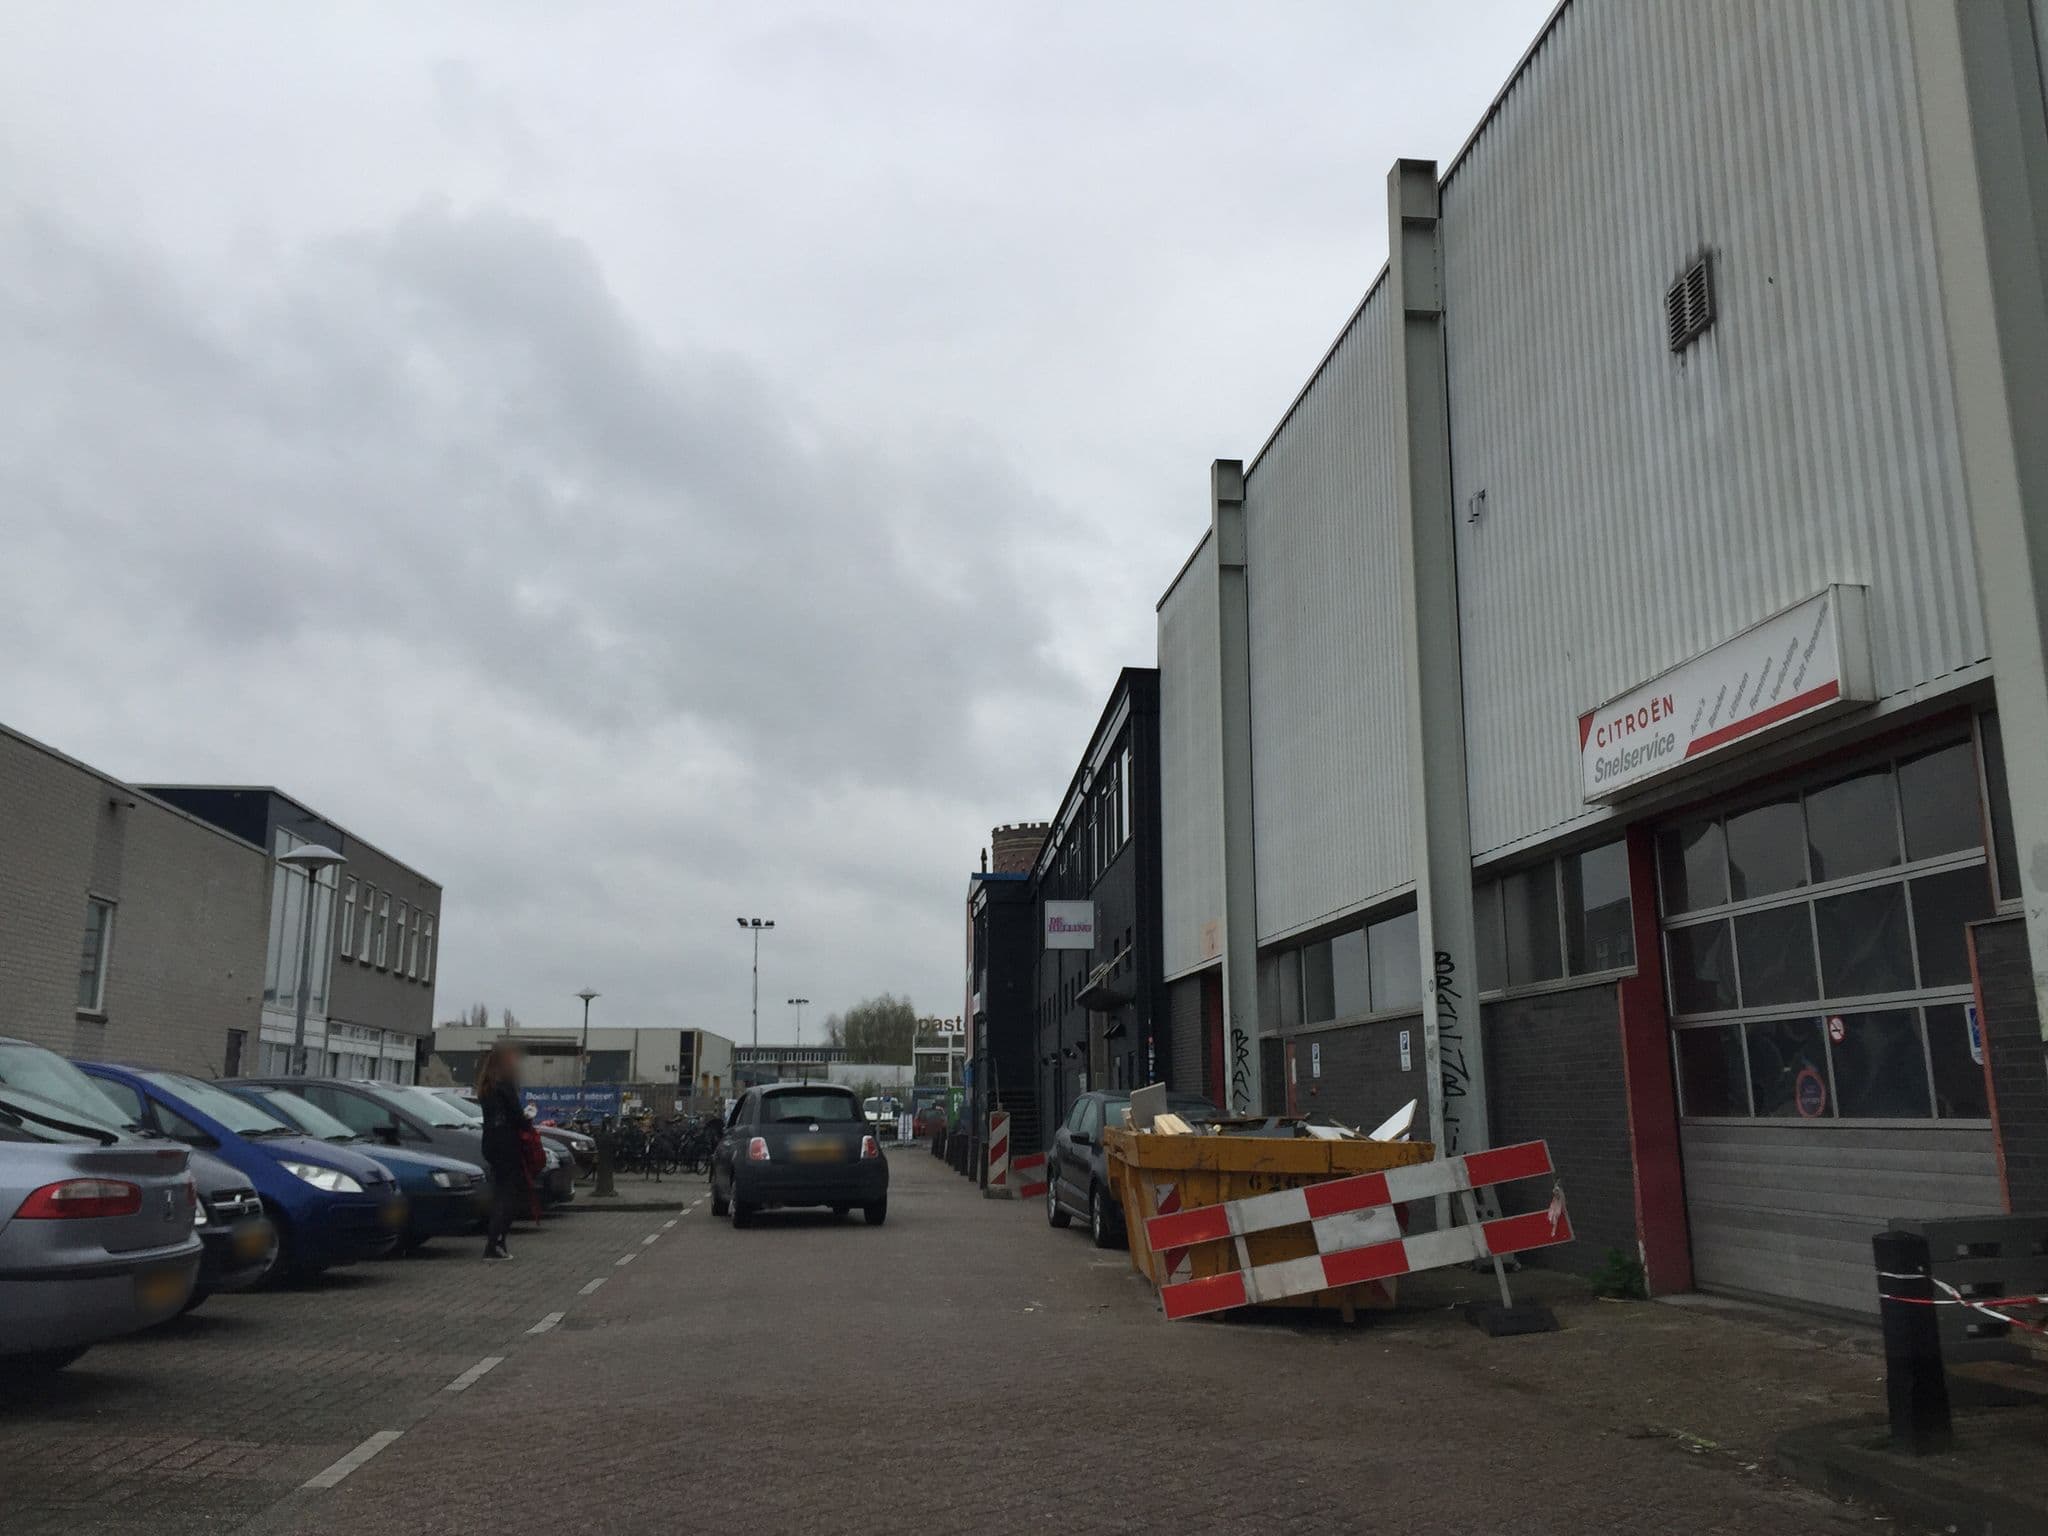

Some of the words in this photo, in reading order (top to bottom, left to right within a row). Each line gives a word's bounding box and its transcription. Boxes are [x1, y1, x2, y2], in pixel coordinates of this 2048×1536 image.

[1597, 694, 1674, 748] CITROËN
[1594, 731, 1676, 783] Snelservice
[918, 1016, 966, 1035] past
